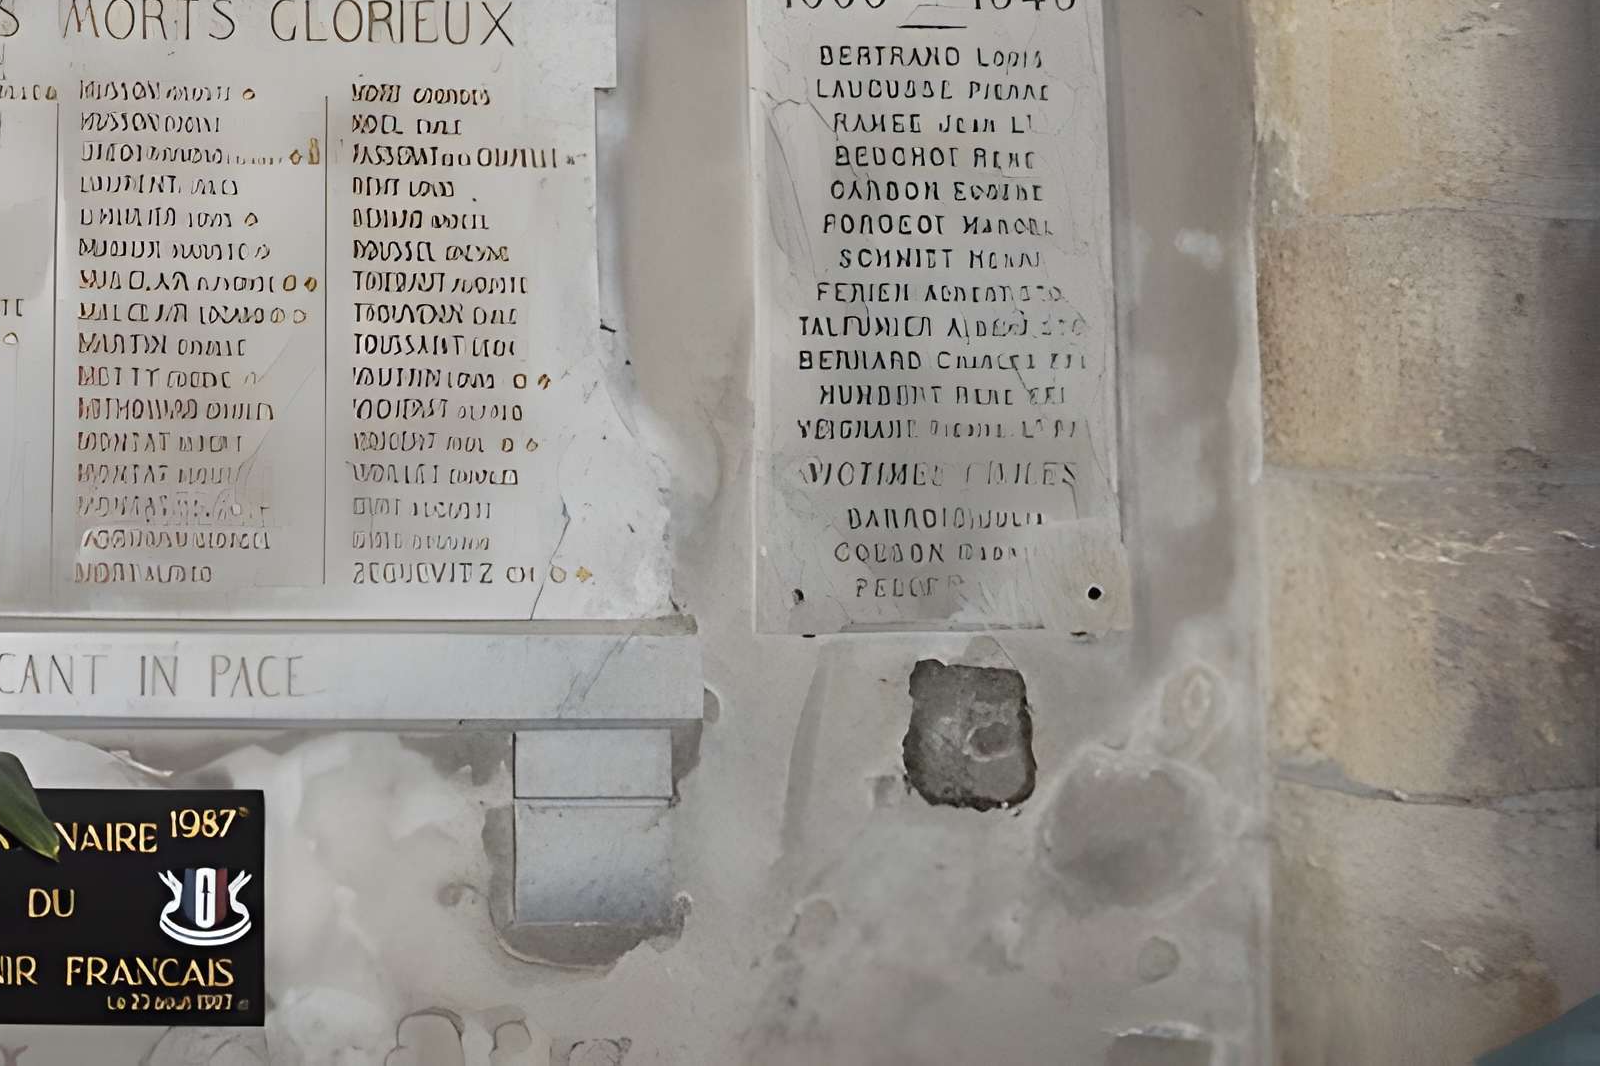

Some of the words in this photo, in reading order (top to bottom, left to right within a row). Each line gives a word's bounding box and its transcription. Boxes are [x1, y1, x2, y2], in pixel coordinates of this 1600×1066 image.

[820, 46, 960, 66] BERTRAND
[141, 652, 179, 698] IN
[210, 654, 306, 698] PACE
[170, 808, 236, 839] 1987
[28, 888, 75, 918] DU
